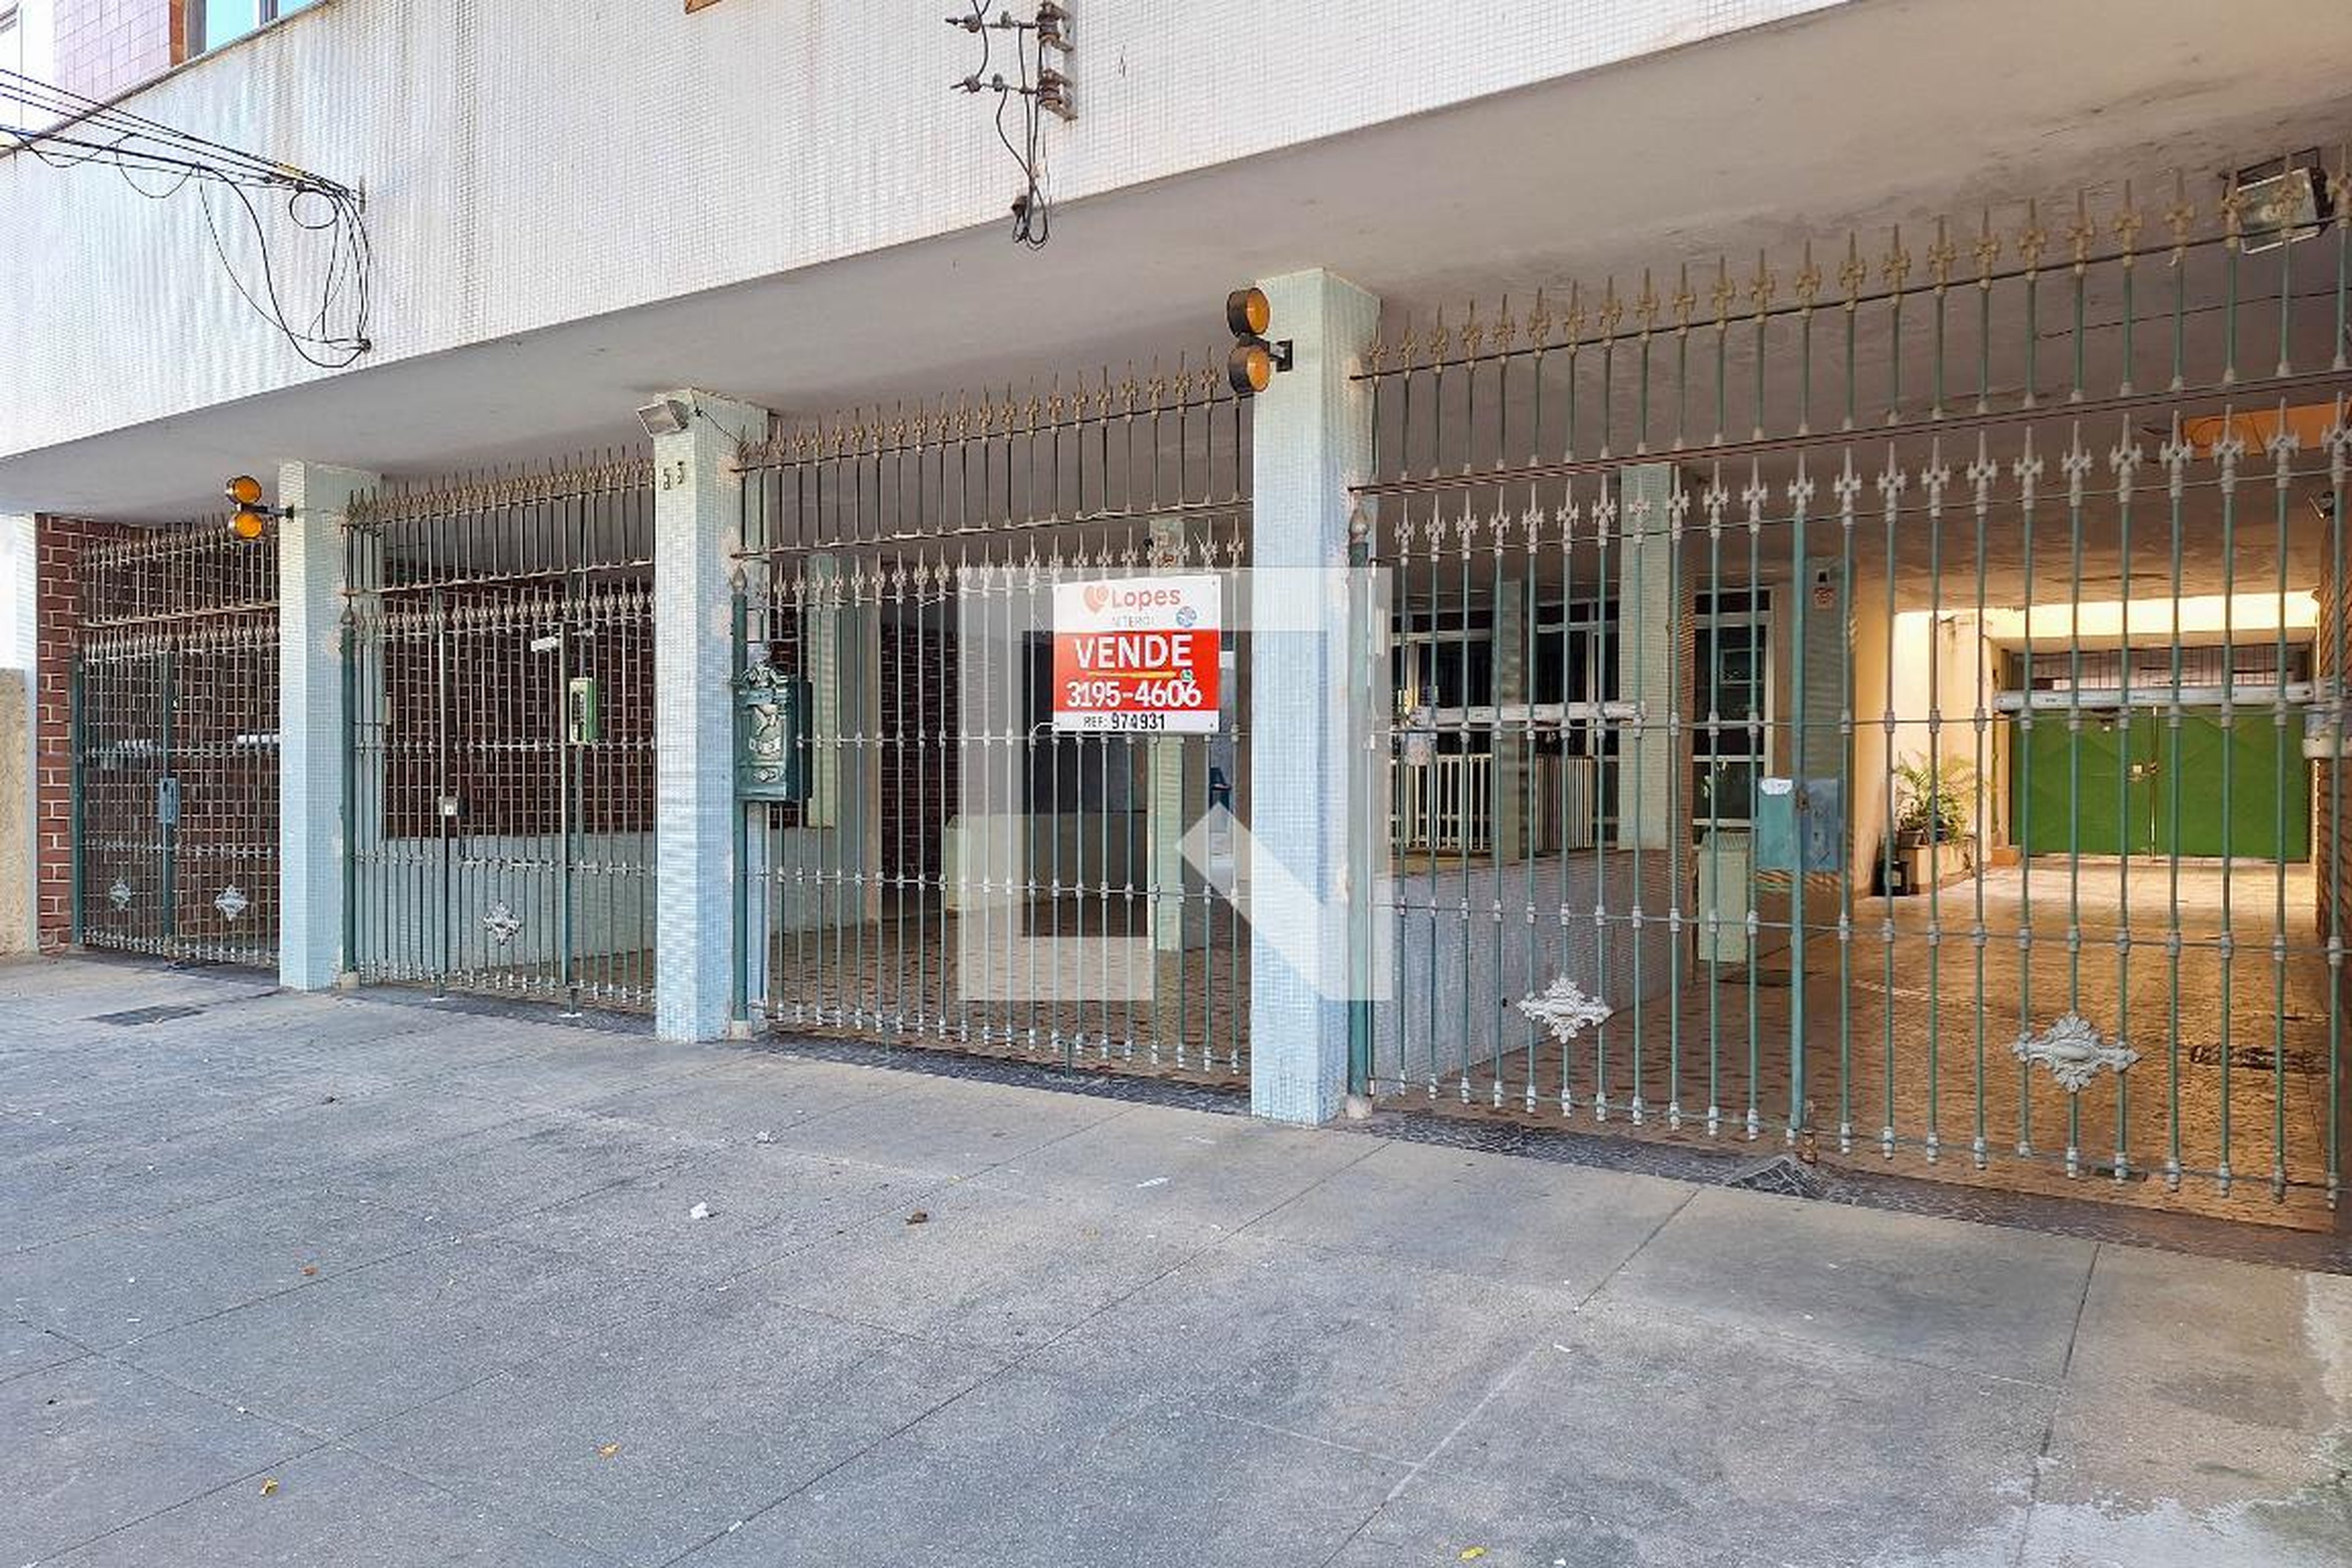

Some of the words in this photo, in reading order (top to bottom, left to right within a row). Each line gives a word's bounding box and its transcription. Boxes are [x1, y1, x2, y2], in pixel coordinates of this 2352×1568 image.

[1112, 589, 1181, 611] Lopes
[1075, 635, 1193, 668] VENDE
[1066, 680, 1202, 708] 3195-4606
[1112, 712, 1166, 729] 974931
